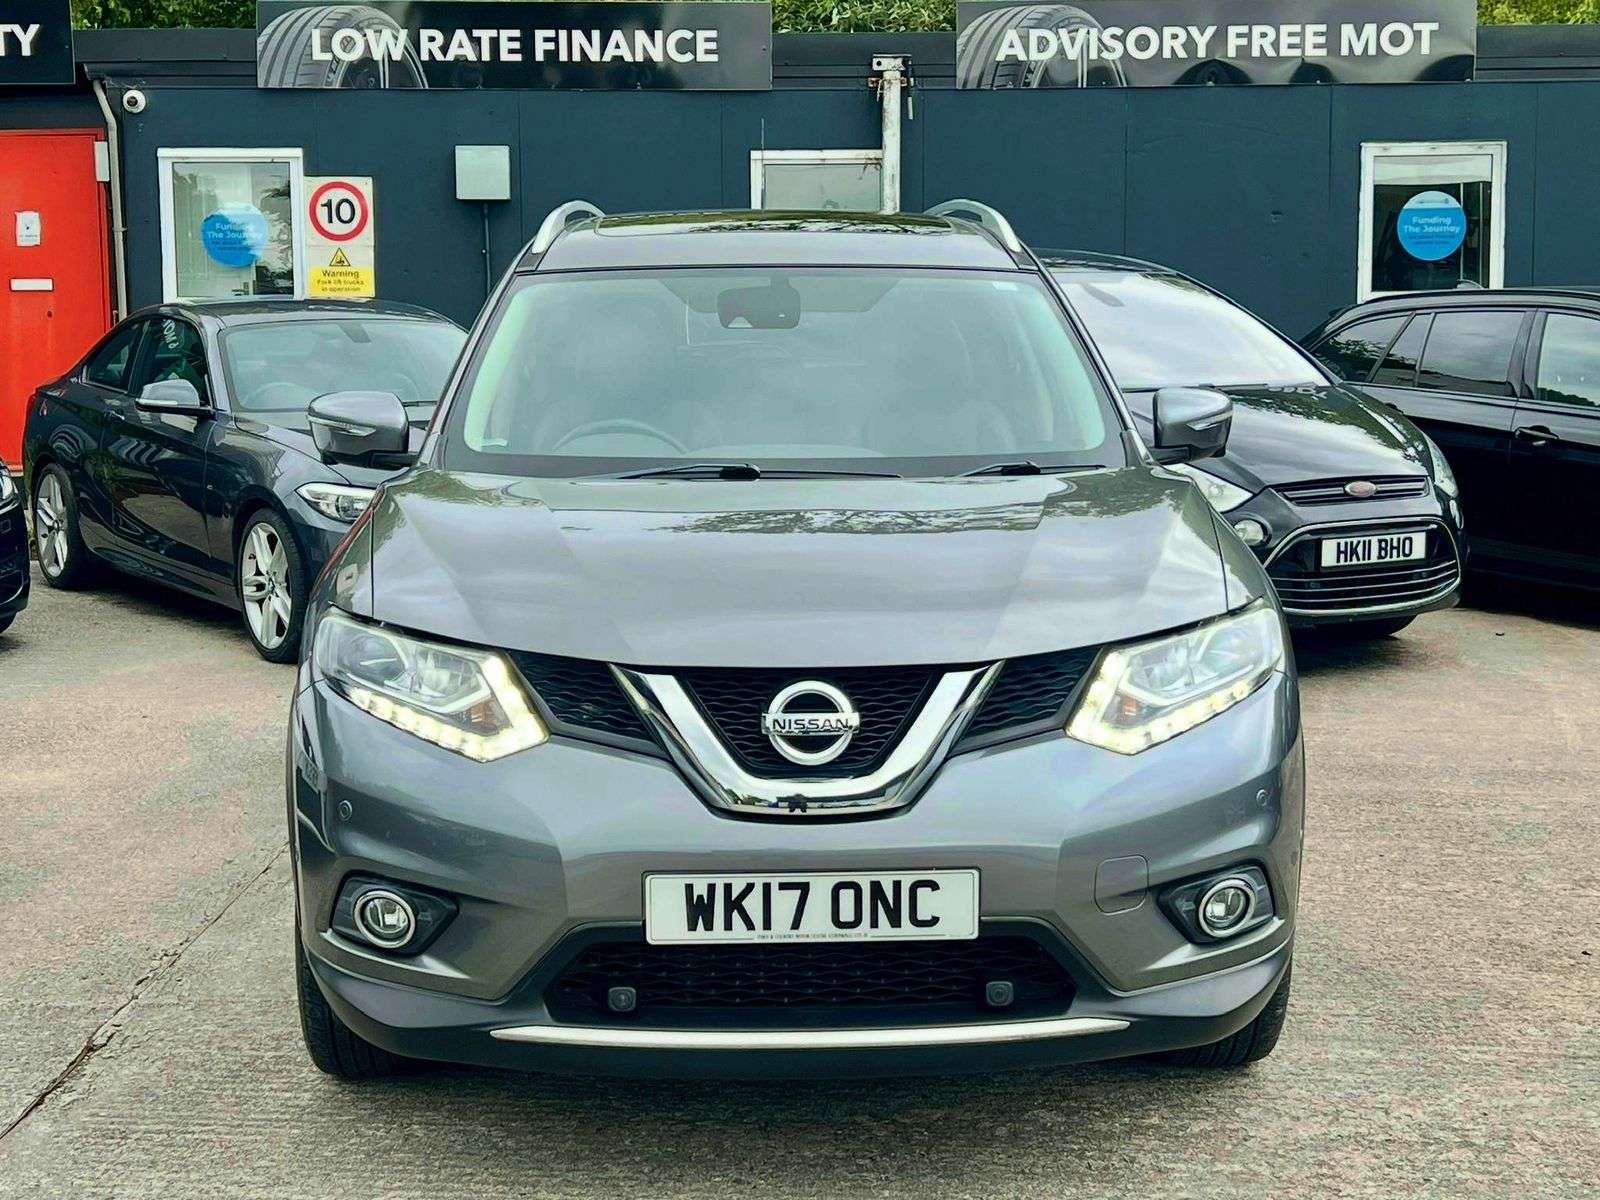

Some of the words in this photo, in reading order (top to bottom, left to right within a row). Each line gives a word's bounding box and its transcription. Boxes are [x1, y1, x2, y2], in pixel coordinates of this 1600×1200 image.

[311, 28, 408, 61] LOW
[419, 29, 523, 61] RATE
[534, 29, 719, 62] FINANCE
[995, 25, 1218, 61] ADVISORY
[1227, 23, 1328, 57] FREE
[1340, 22, 1440, 56] MOT
[321, 198, 356, 224] 10
[1412, 216, 1452, 225] Funding
[206, 231, 224, 239] The
[1404, 225, 1420, 233] The
[1423, 225, 1460, 233] Journey
[322, 269, 360, 279] Warning
[1336, 539, 1372, 564] HK11
[1377, 536, 1413, 560] BHO
[772, 718, 849, 731] NISSAN
[684, 881, 810, 932] WK17
[831, 879, 941, 930] ONC
